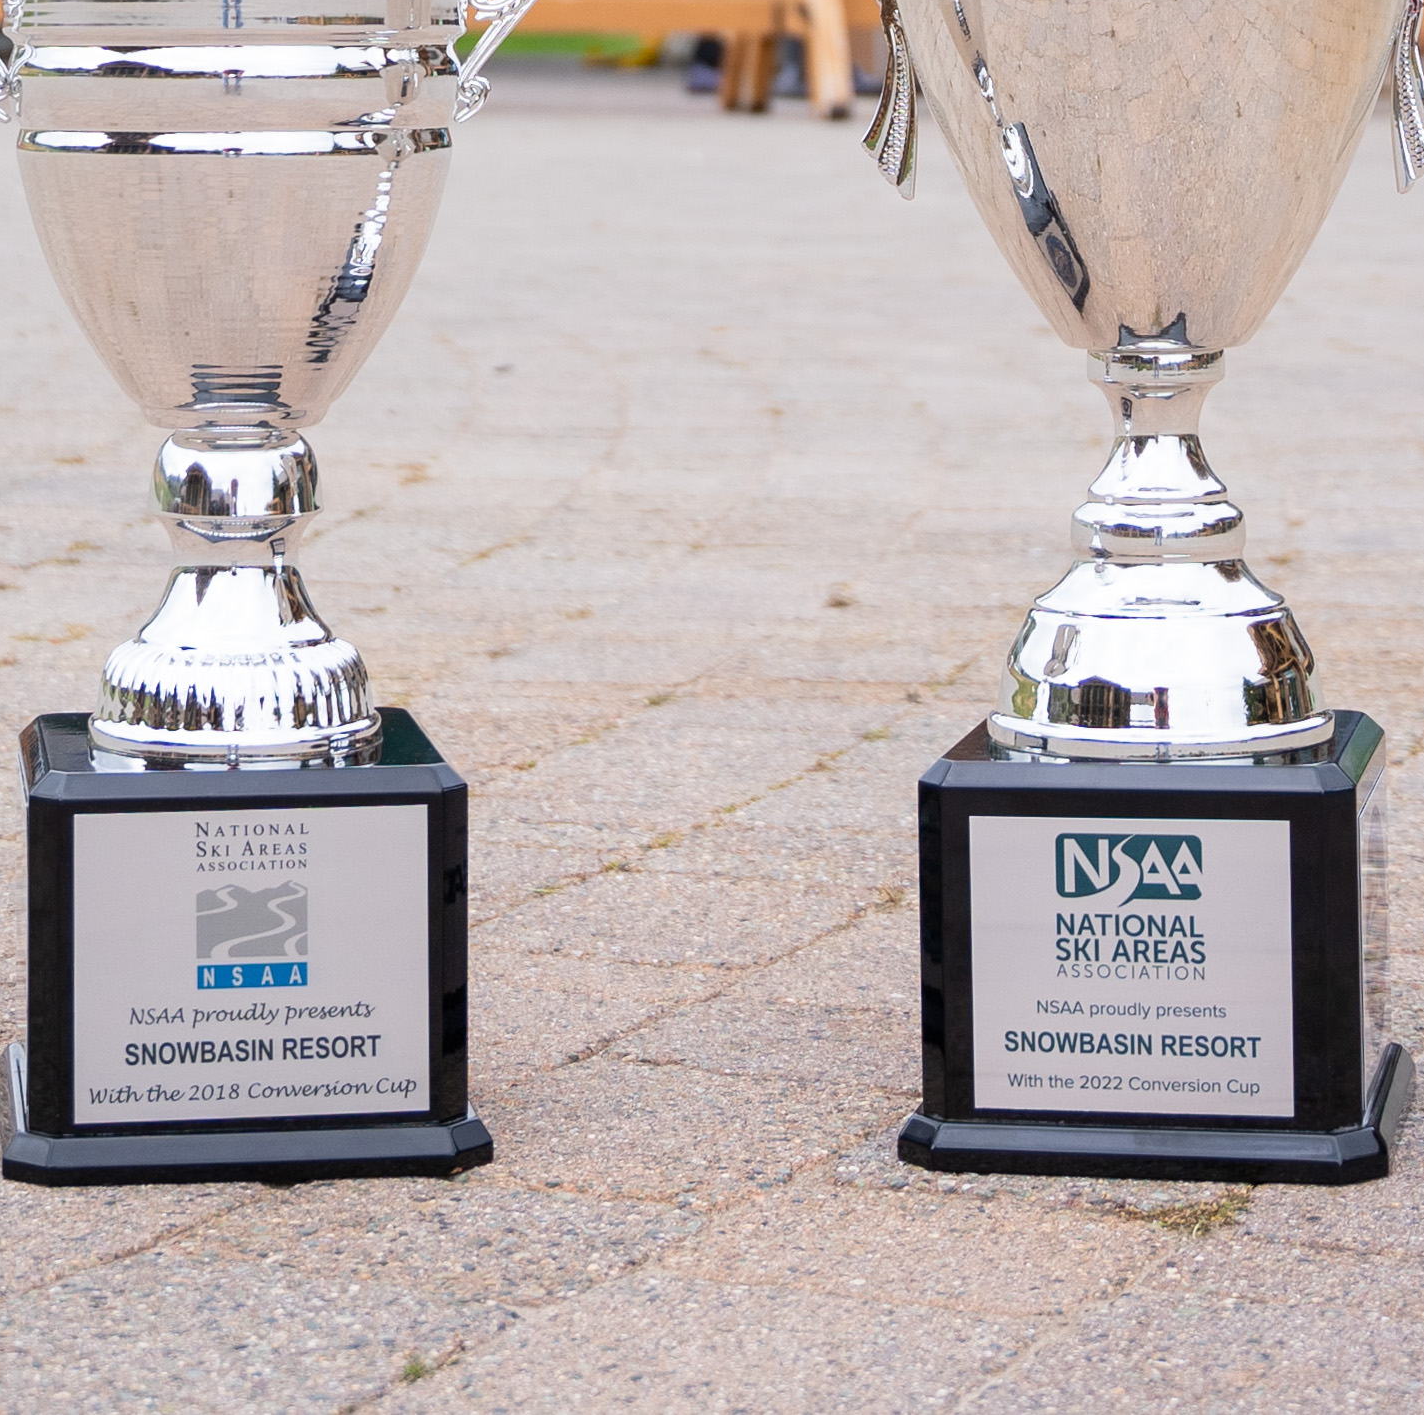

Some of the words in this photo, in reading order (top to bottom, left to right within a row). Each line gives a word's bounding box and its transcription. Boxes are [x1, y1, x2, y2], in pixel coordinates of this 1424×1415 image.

[196, 859, 308, 872] ASSOCIATION
[1059, 833, 1203, 907] NSAA
[1056, 912, 1204, 938] NATIONAL
[1055, 938, 1101, 962] SKI
[1111, 939, 1206, 964] AREAS
[202, 964, 303, 987] NSAA
[1056, 963, 1206, 981] ASSOCIATION
[129, 1006, 185, 1026] NSAA
[192, 1002, 280, 1028] proudly
[284, 1000, 375, 1024] presents
[1036, 999, 1084, 1015] NSAA
[1089, 1001, 1151, 1020] proudly
[1156, 1004, 1227, 1020] presents
[124, 1039, 273, 1066] SNOWBASIN
[282, 1035, 381, 1061] RESORT
[1004, 1030, 1153, 1056] SNOWBASIN
[1161, 1034, 1261, 1058] RESORT
[89, 1084, 143, 1105] With
[146, 1084, 185, 1103] the
[188, 1083, 240, 1101] 2018
[247, 1079, 374, 1100] Conversion
[376, 1077, 417, 1098] Cup
[1007, 1072, 1043, 1088] With
[1048, 1073, 1075, 1089] the
[1079, 1074, 1123, 1090] 2022
[1128, 1075, 1221, 1093] Conversion
[1226, 1079, 1261, 1097] Cup
